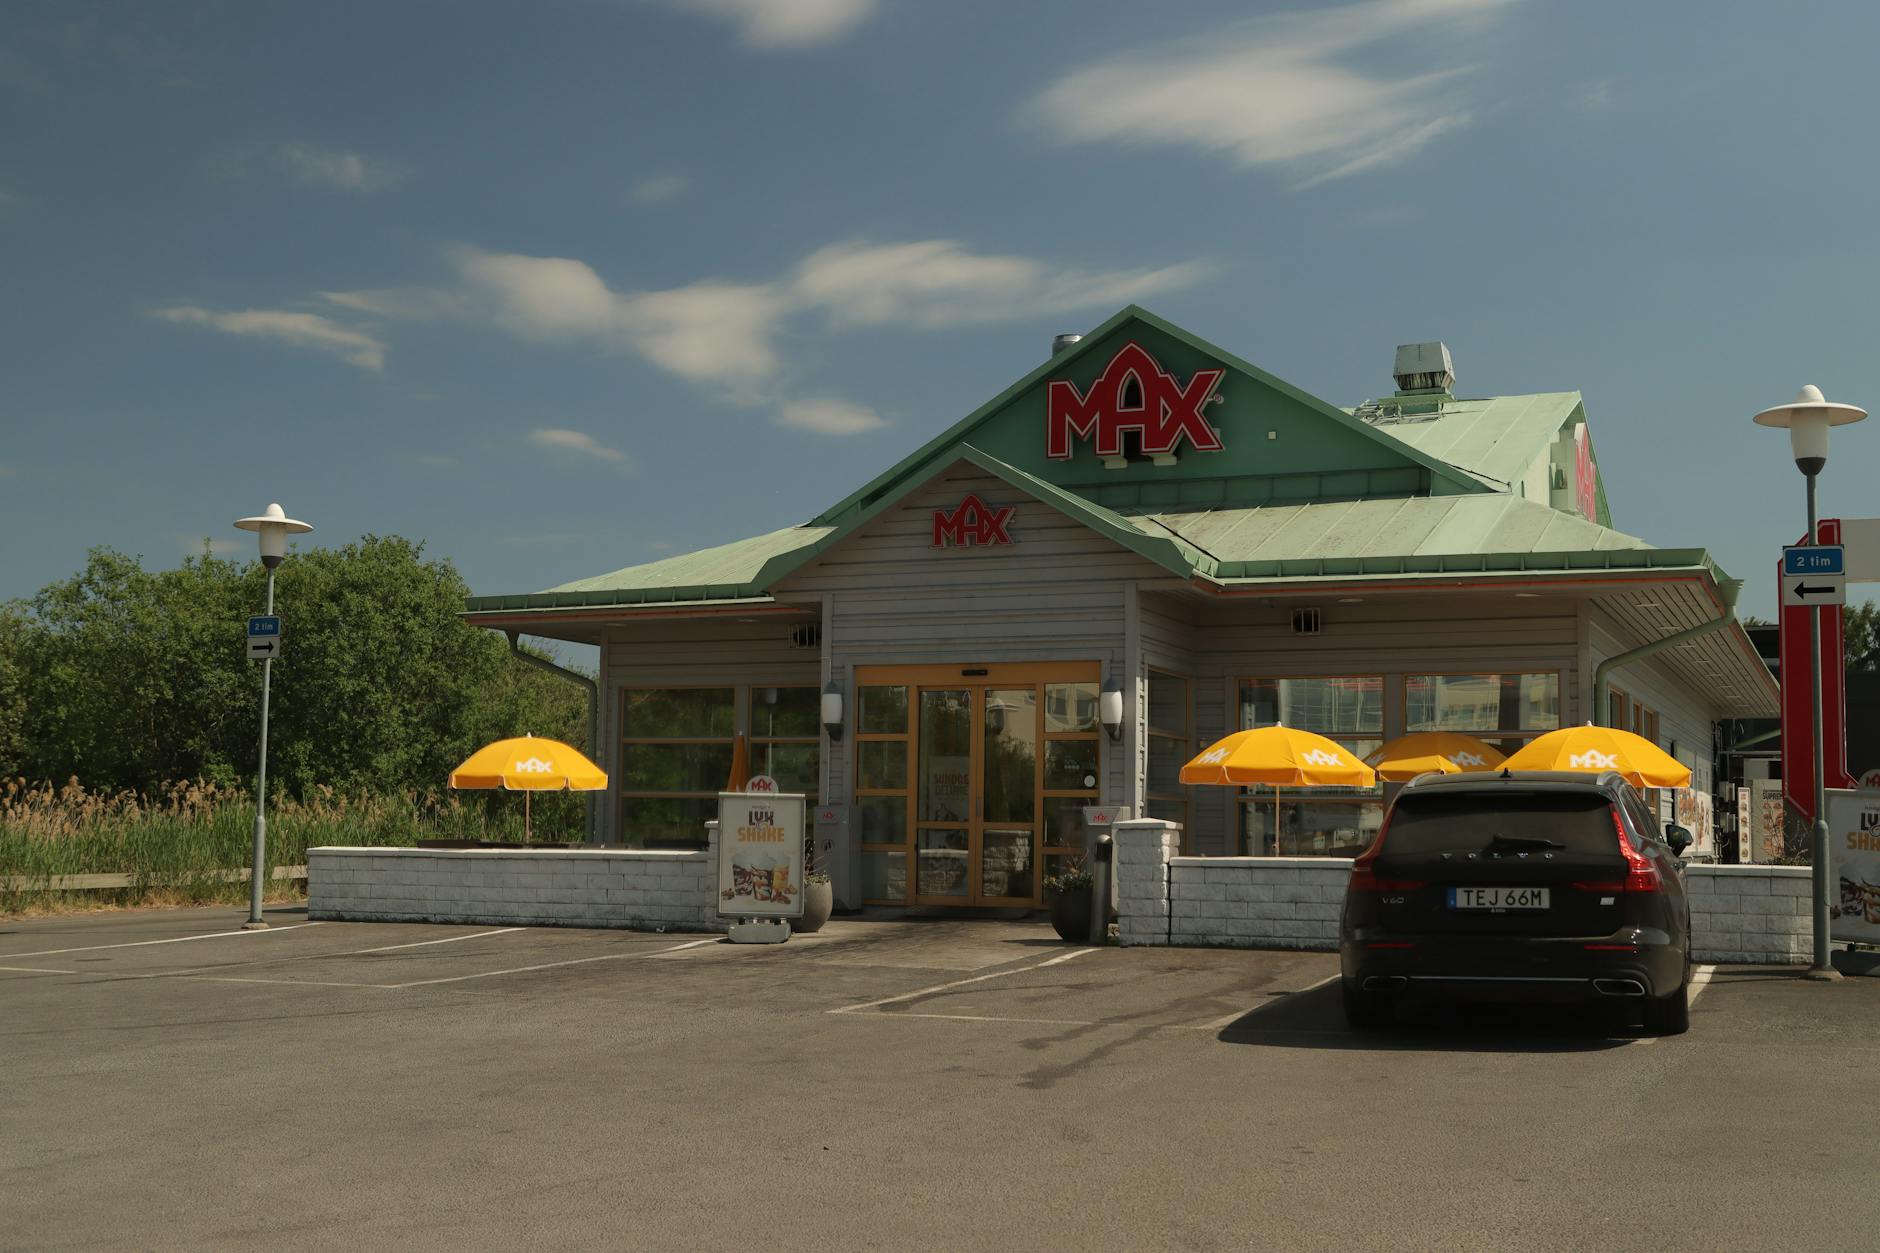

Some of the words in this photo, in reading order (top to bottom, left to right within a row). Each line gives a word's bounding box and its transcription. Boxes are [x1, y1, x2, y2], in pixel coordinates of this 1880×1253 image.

[1046, 340, 1225, 460] MAX
[932, 493, 1016, 549] MAX
[1796, 556, 1805, 567] 2
[1810, 556, 1831, 567] tim
[515, 757, 553, 773] MAX
[1302, 748, 1346, 767] MAX
[1447, 750, 1487, 767] MAX
[1569, 749, 1618, 768] MAX
[751, 778, 773, 791] MAX
[737, 827, 785, 842] SHAKE
[1441, 852, 1553, 860] VOLVO
[1382, 896, 1405, 904] V60
[1463, 889, 1499, 906] TEJ
[1504, 889, 1542, 906] 66M
